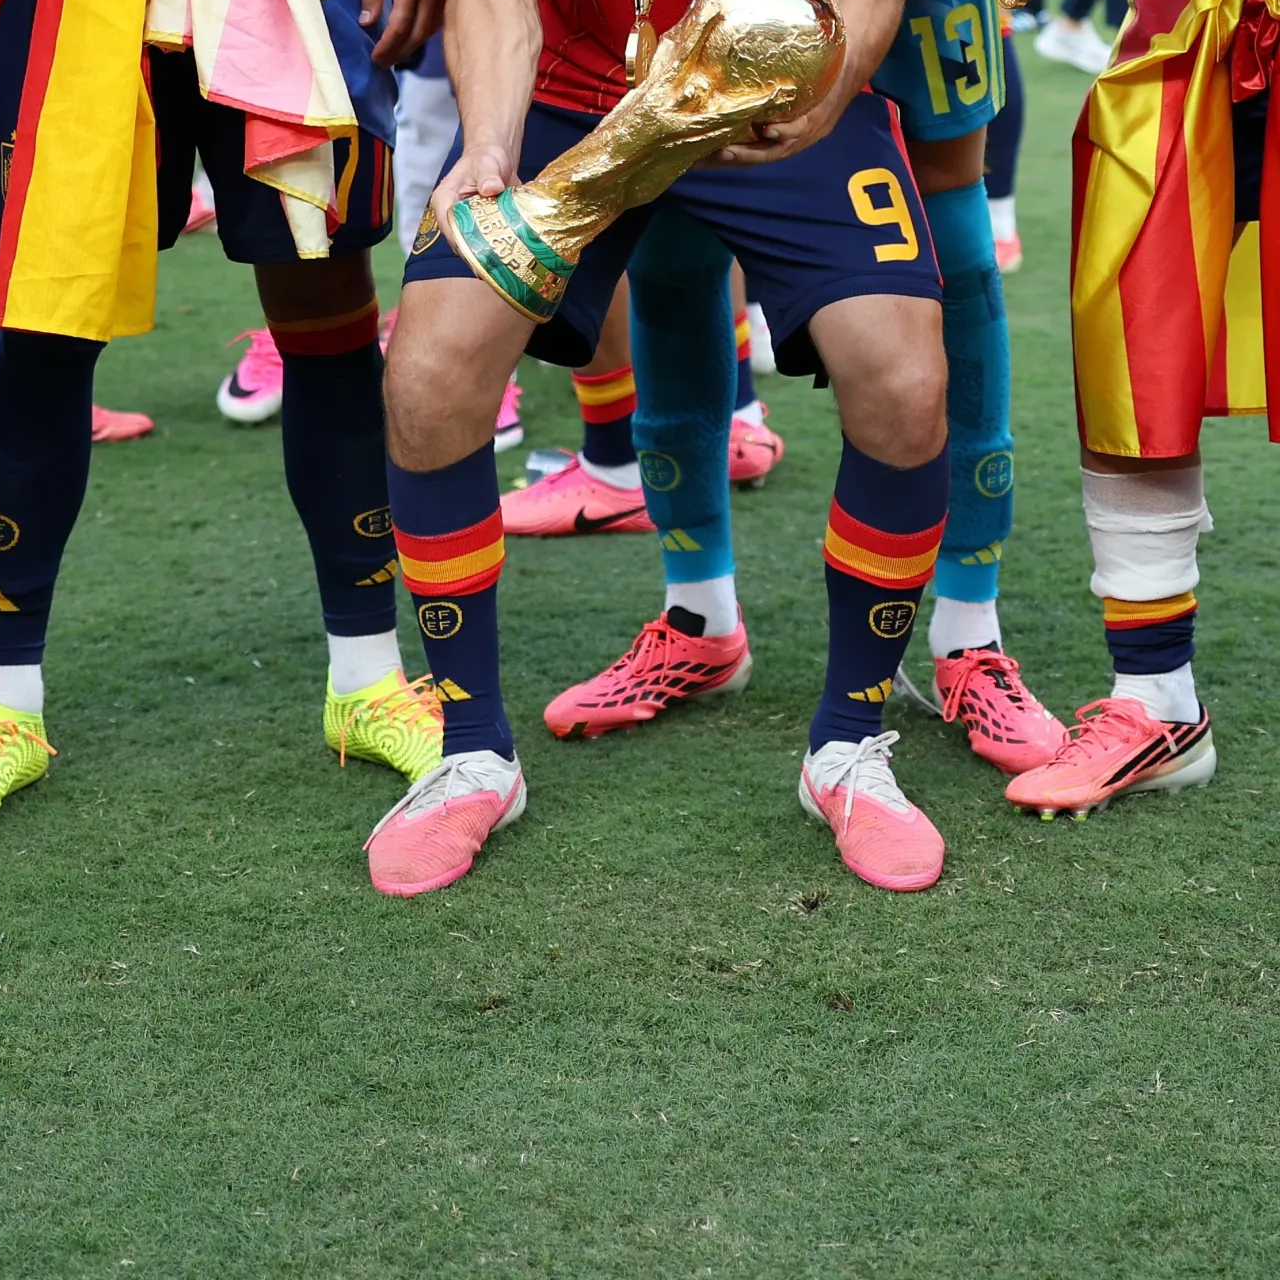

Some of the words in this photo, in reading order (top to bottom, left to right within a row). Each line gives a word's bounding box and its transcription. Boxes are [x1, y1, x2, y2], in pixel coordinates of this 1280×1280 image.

[912, 2, 990, 117] 13
[846, 168, 919, 263] 9
[489, 237, 521, 269] CUP
[988, 461, 1009, 475] RF
[987, 475, 1008, 488] EF
[426, 609, 450, 620] RF
[882, 608, 909, 619] RF
[427, 621, 451, 631] EF
[881, 619, 906, 630] EF
